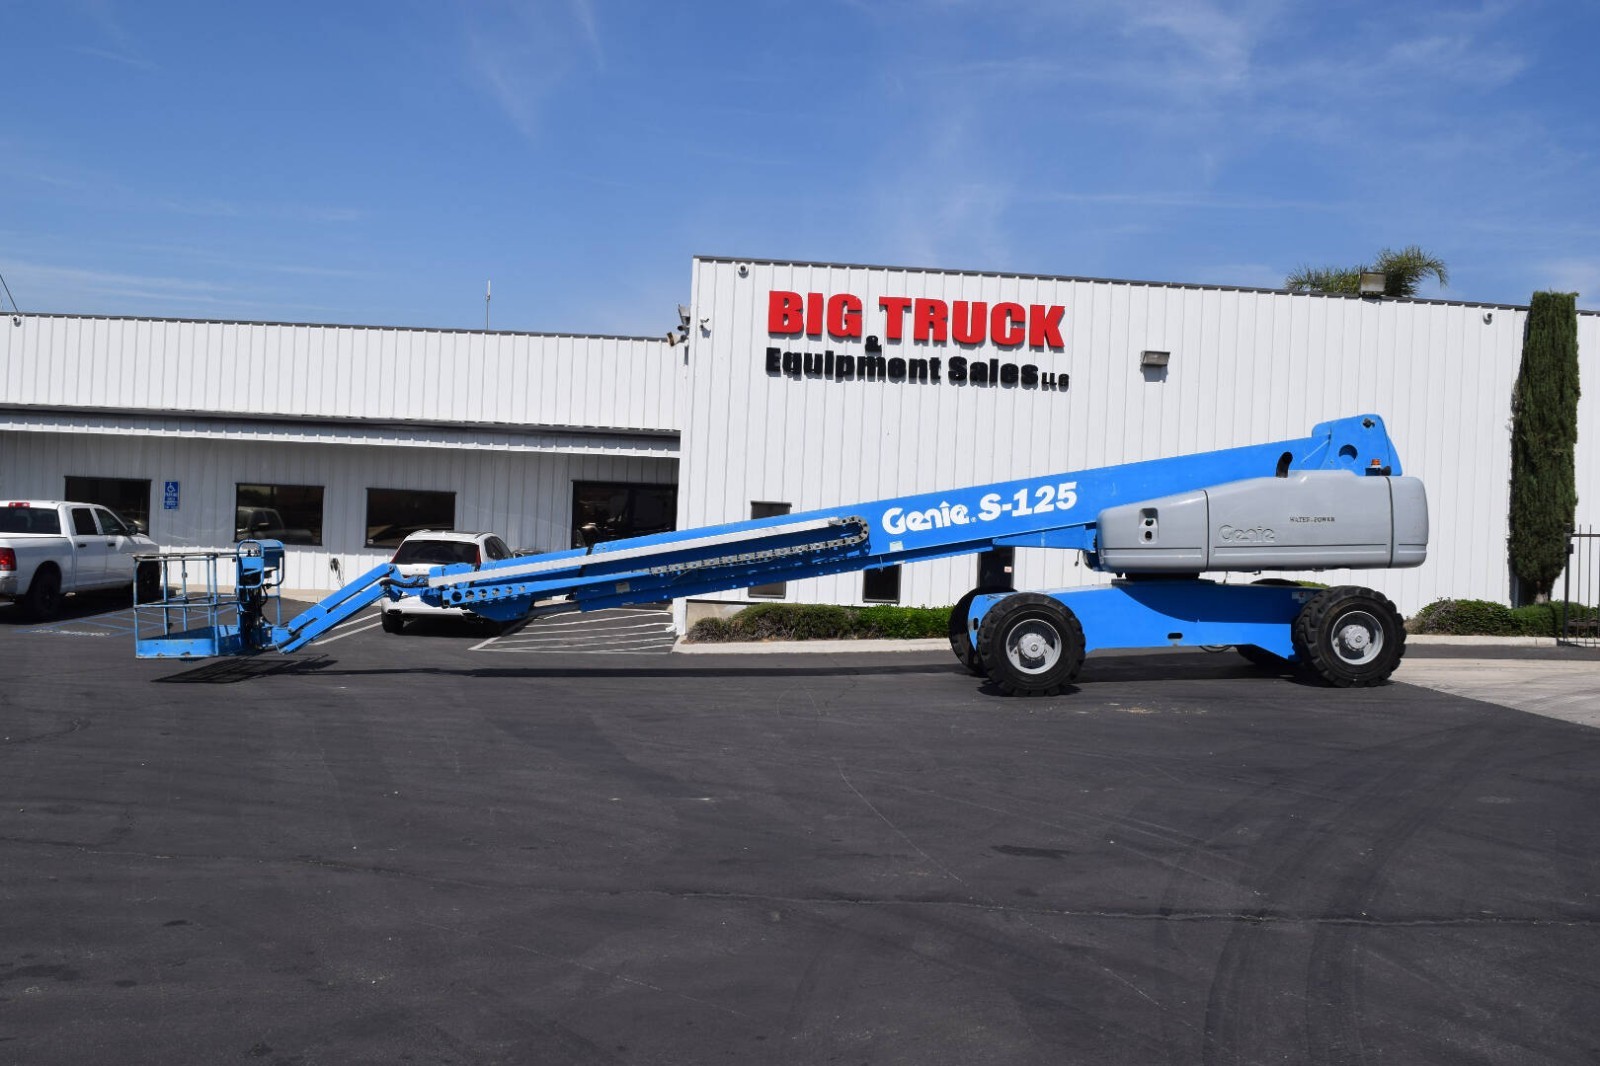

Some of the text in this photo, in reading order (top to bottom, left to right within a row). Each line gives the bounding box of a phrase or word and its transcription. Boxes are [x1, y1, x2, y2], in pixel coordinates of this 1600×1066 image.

[768, 290, 1066, 348] BIG TRUCK
[865, 335, 882, 352] &
[766, 347, 942, 380] Equipment
[948, 356, 1039, 386] Sales
[882, 482, 1077, 535] Genie S-125
[1219, 524, 1275, 543] Genie
